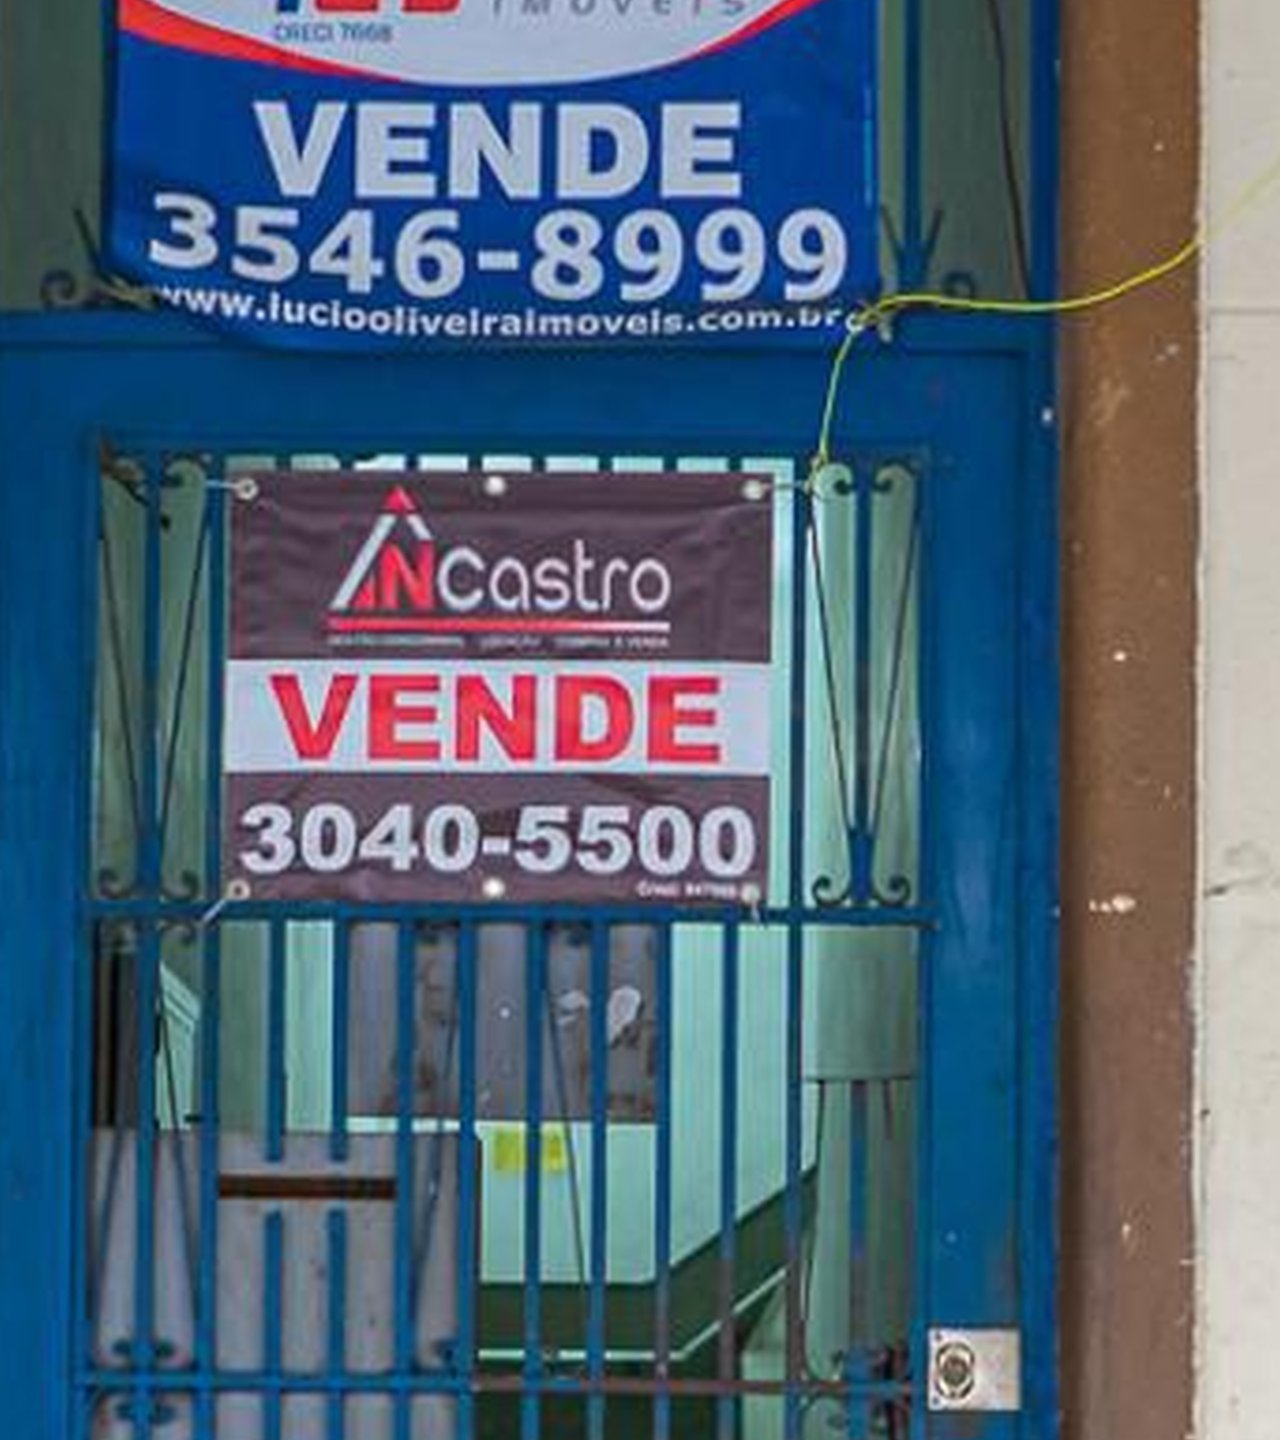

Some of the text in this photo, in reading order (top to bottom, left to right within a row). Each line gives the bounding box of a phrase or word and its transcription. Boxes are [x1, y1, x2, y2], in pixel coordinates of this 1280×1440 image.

[253, 101, 742, 199] VENDE
[148, 192, 848, 302] 3546-8999
[158, 288, 842, 337] www.luciooliveiraimoveis.com.br
[269, 674, 721, 764] VENDE
[239, 802, 757, 877] 3040-5500
